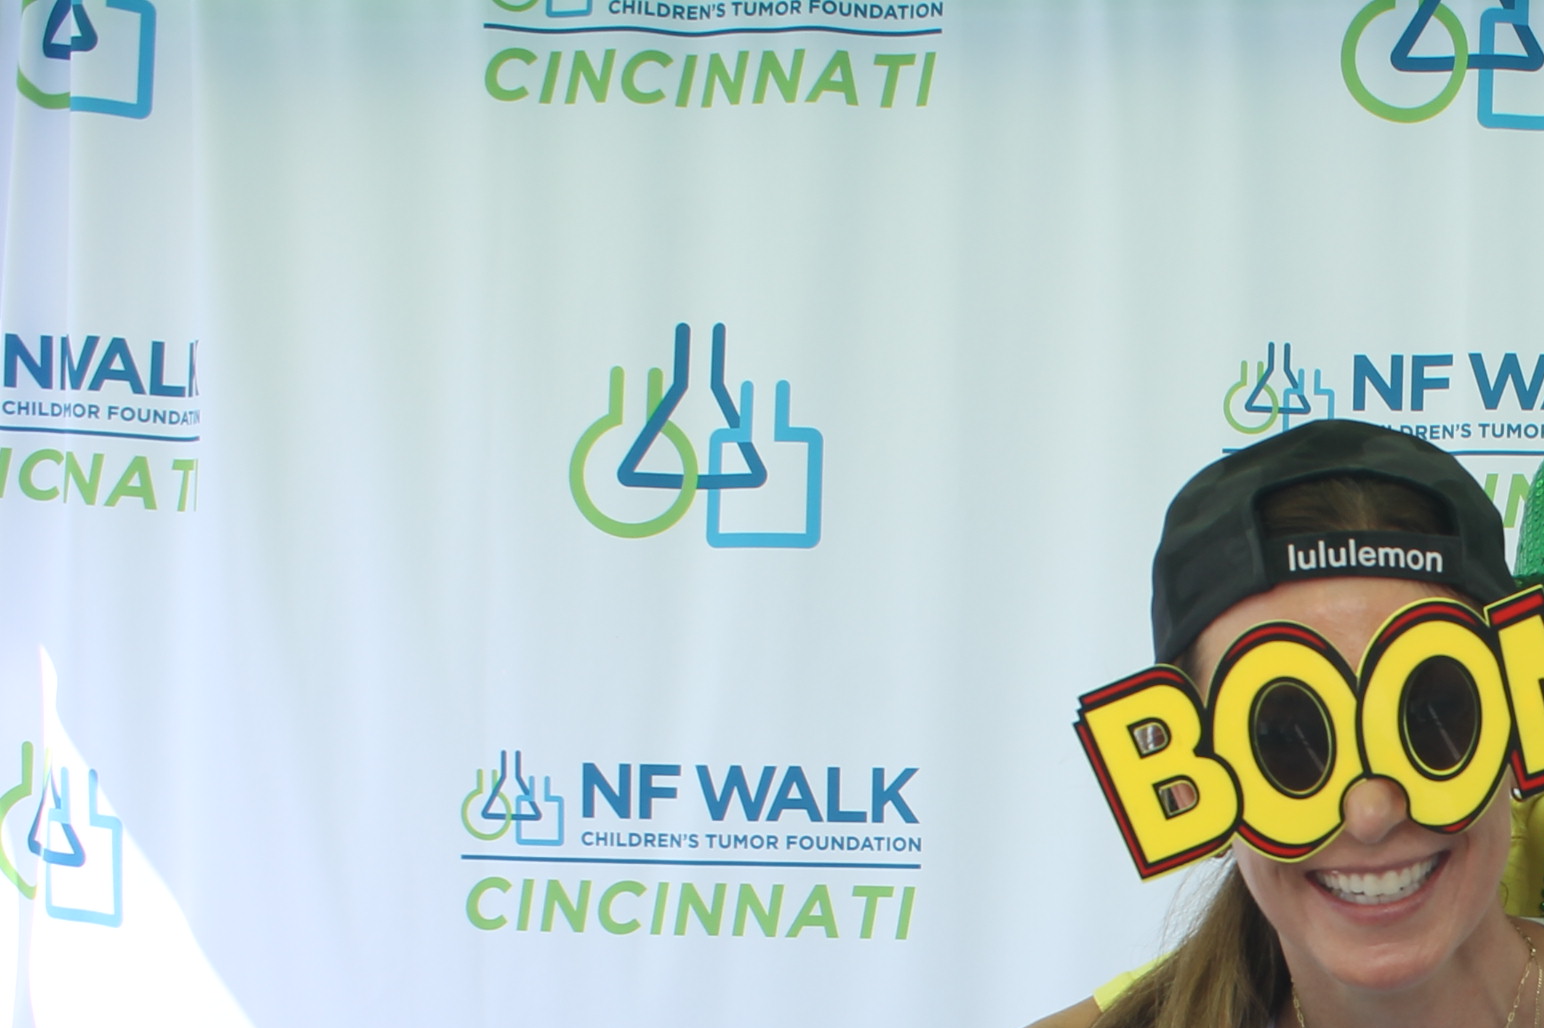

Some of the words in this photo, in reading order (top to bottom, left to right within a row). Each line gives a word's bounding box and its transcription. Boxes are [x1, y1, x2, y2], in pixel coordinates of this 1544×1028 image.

[608, 0, 726, 20] CHILDREN'S
[732, 0, 801, 16] TUMOR
[808, 0, 944, 20] FOUNDATION
[484, 47, 936, 108] CINCINNATI
[1352, 354, 1454, 411] NF
[1287, 538, 1444, 575] lululemon
[582, 762, 682, 820] NF
[695, 764, 921, 825] WALK
[581, 831, 700, 849] CHILDREN'S
[705, 834, 778, 850] TUMOR
[786, 835, 922, 853] FOUNDATION
[466, 876, 917, 941] CINCINNATI
